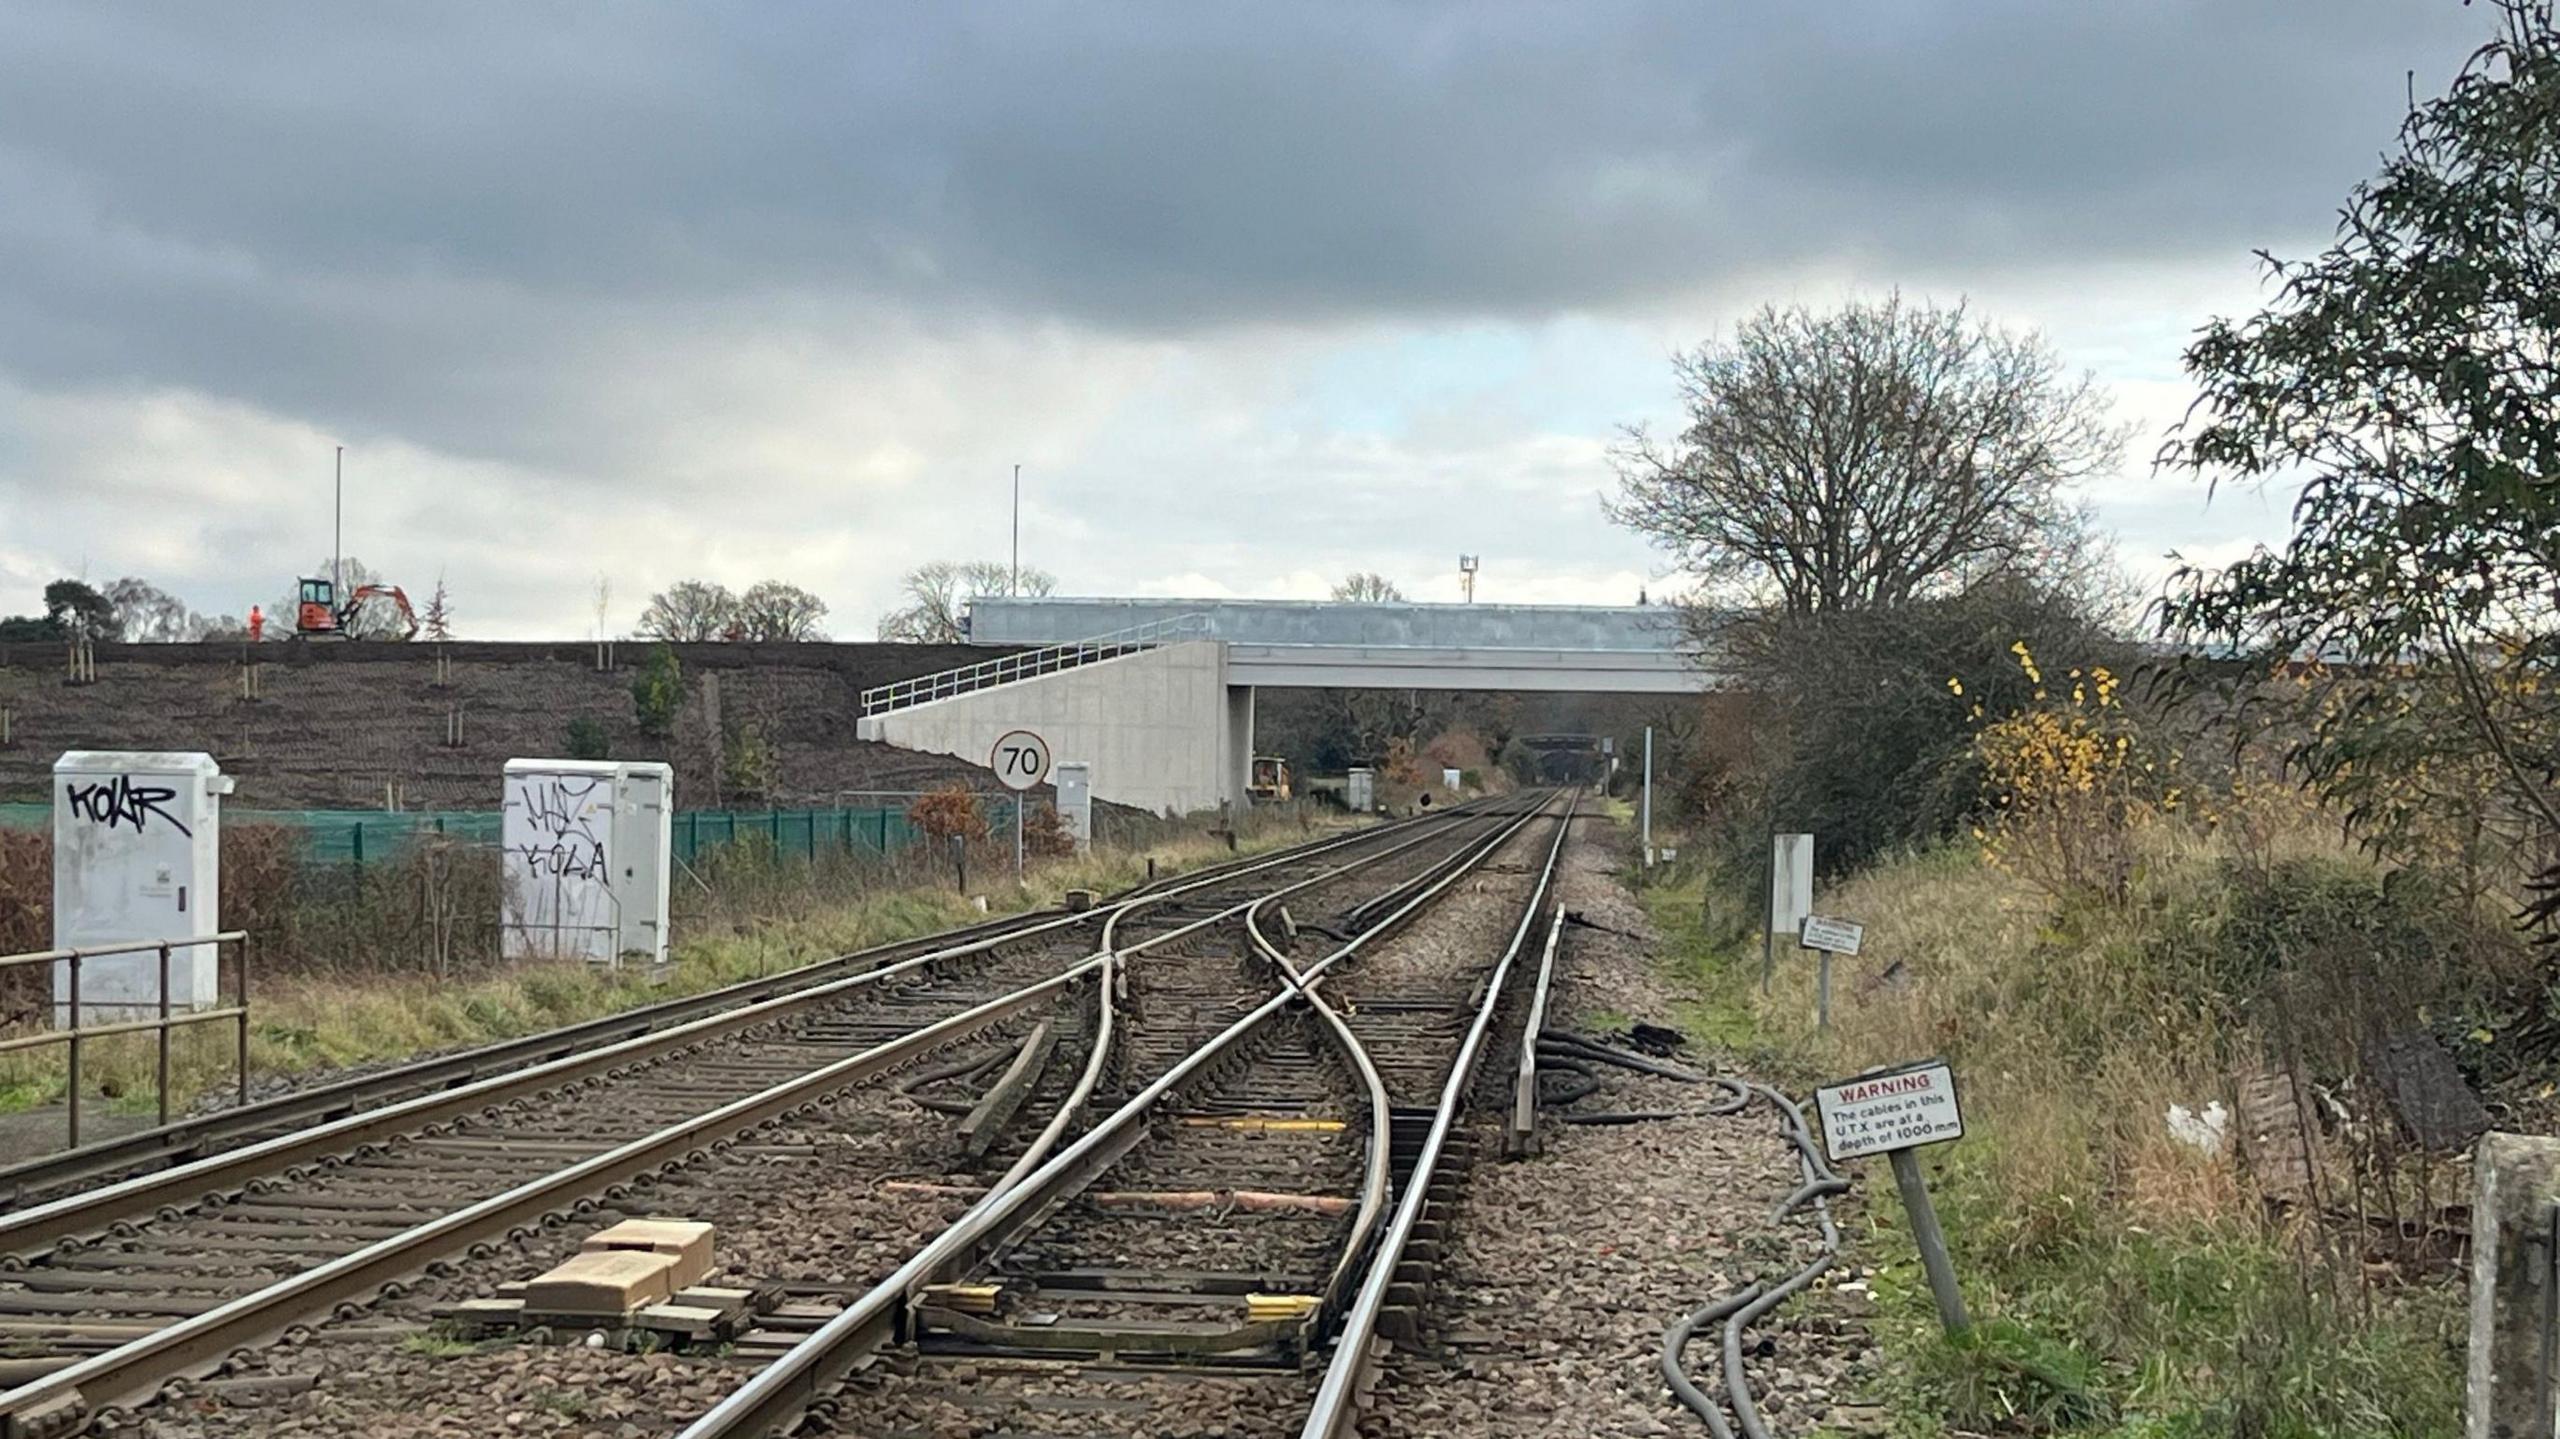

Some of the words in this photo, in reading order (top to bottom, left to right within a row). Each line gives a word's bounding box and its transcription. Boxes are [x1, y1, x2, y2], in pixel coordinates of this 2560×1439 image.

[1003, 747, 1039, 775] 70
[1839, 1074, 1932, 1102] WARNING
[1832, 1111, 1856, 1123] The
[1860, 1102, 1902, 1118] cables
[1905, 1098, 1918, 1110] in
[1920, 1094, 1945, 1106] this
[1875, 1119, 1895, 1130] are
[1899, 1113, 1913, 1126] at
[1916, 1113, 1924, 1122] a
[1838, 1135, 1876, 1151] depth
[1879, 1131, 1893, 1143] of
[1897, 1124, 1933, 1139] 1000
